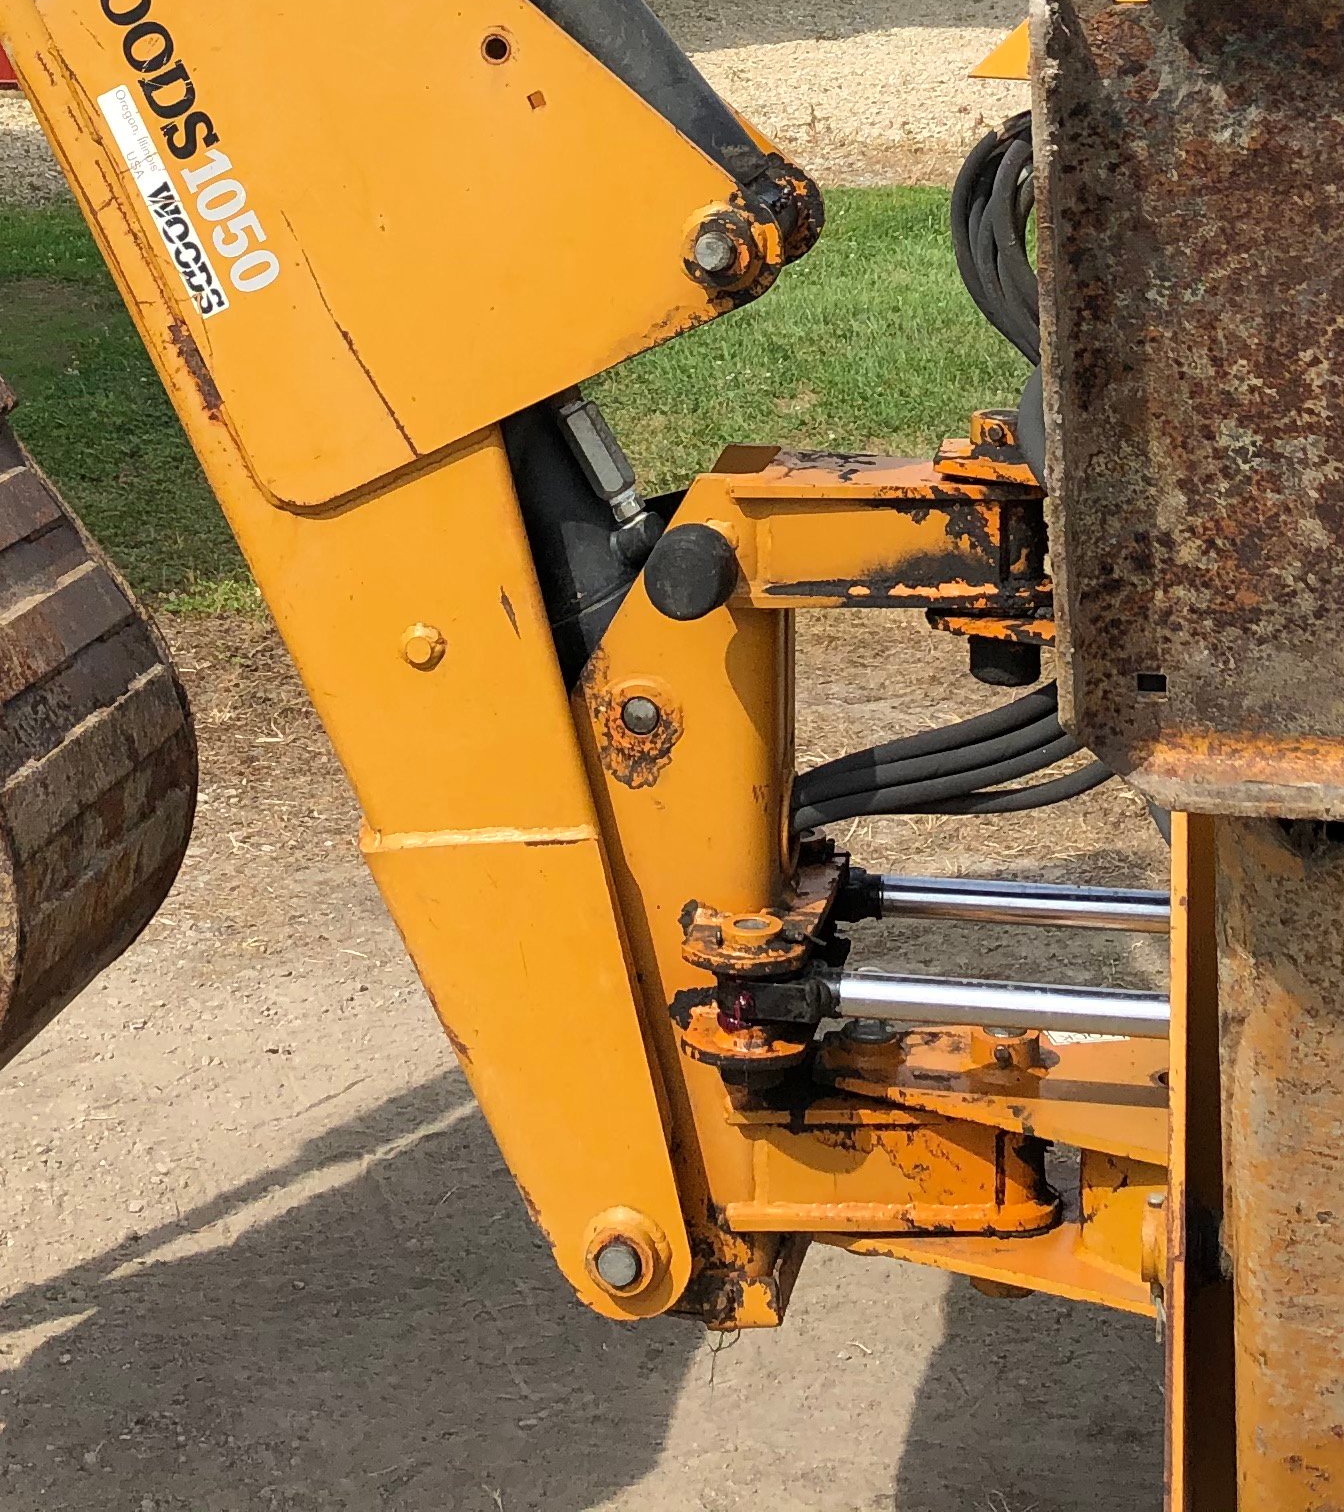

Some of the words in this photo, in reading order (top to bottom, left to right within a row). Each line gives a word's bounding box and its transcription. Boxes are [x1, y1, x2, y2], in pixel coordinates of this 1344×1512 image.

[115, 89, 139, 135] Oregon,
[126, 150, 145, 180] USA
[147, 181, 226, 314] WOODS
[181, 149, 280, 293] 1050
